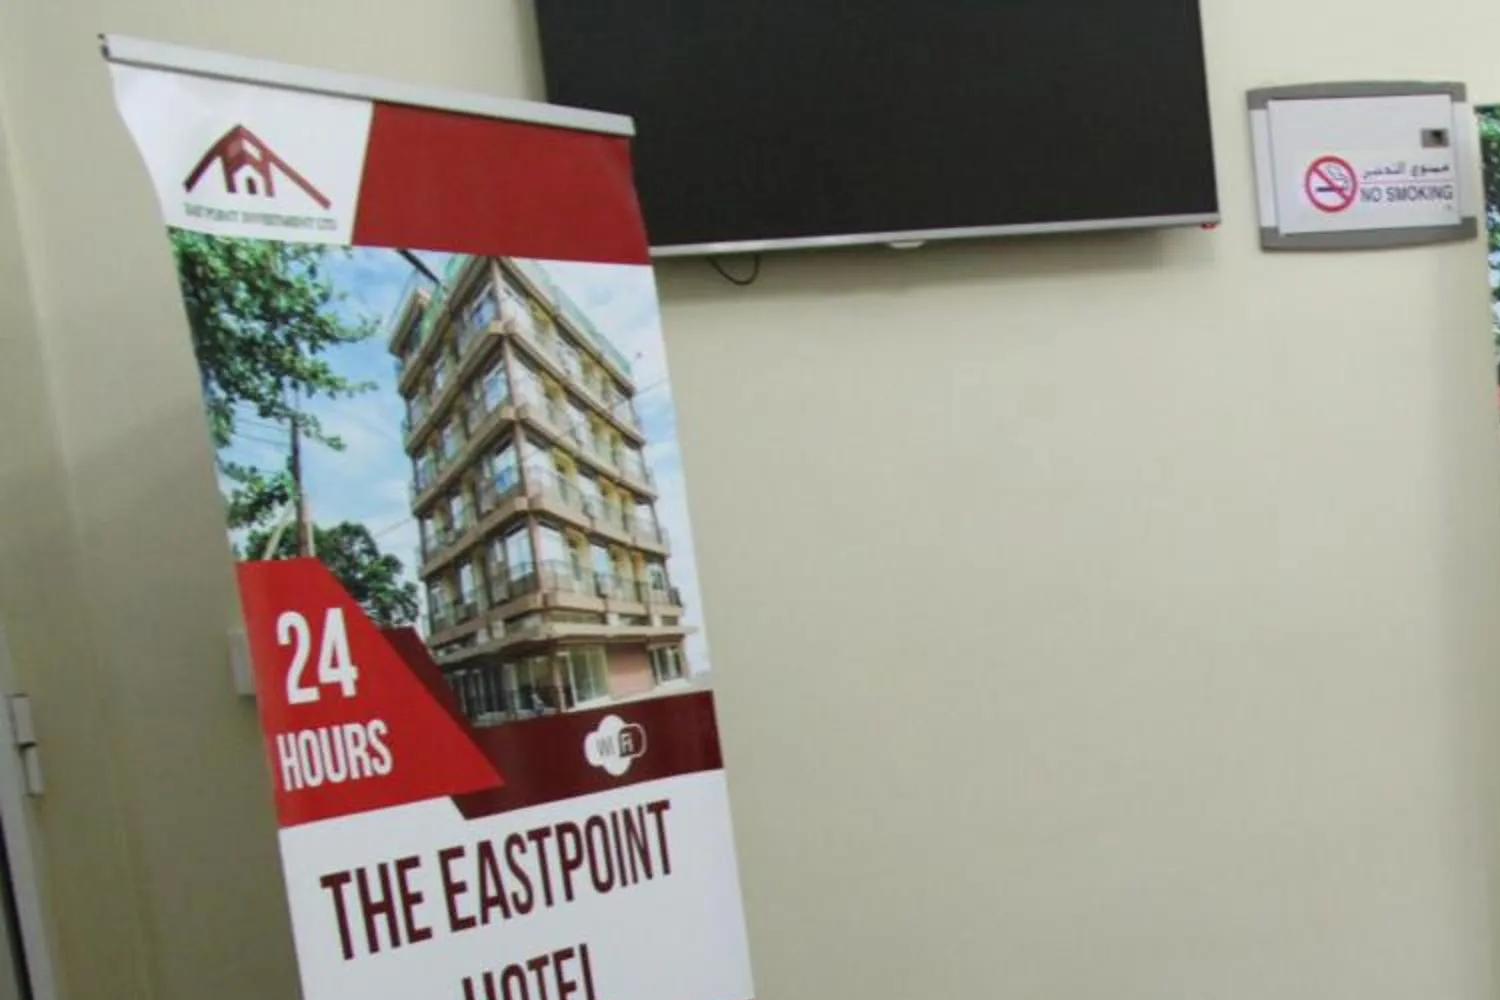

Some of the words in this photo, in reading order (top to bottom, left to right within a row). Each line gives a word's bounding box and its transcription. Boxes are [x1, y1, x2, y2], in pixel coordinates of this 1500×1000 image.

[1360, 187, 1381, 202] NO
[1386, 185, 1453, 202] SMOKING
[277, 607, 359, 704] 24
[277, 718, 393, 792] HOURS
[320, 855, 432, 960] THE
[438, 800, 671, 933] EASTPOINT
